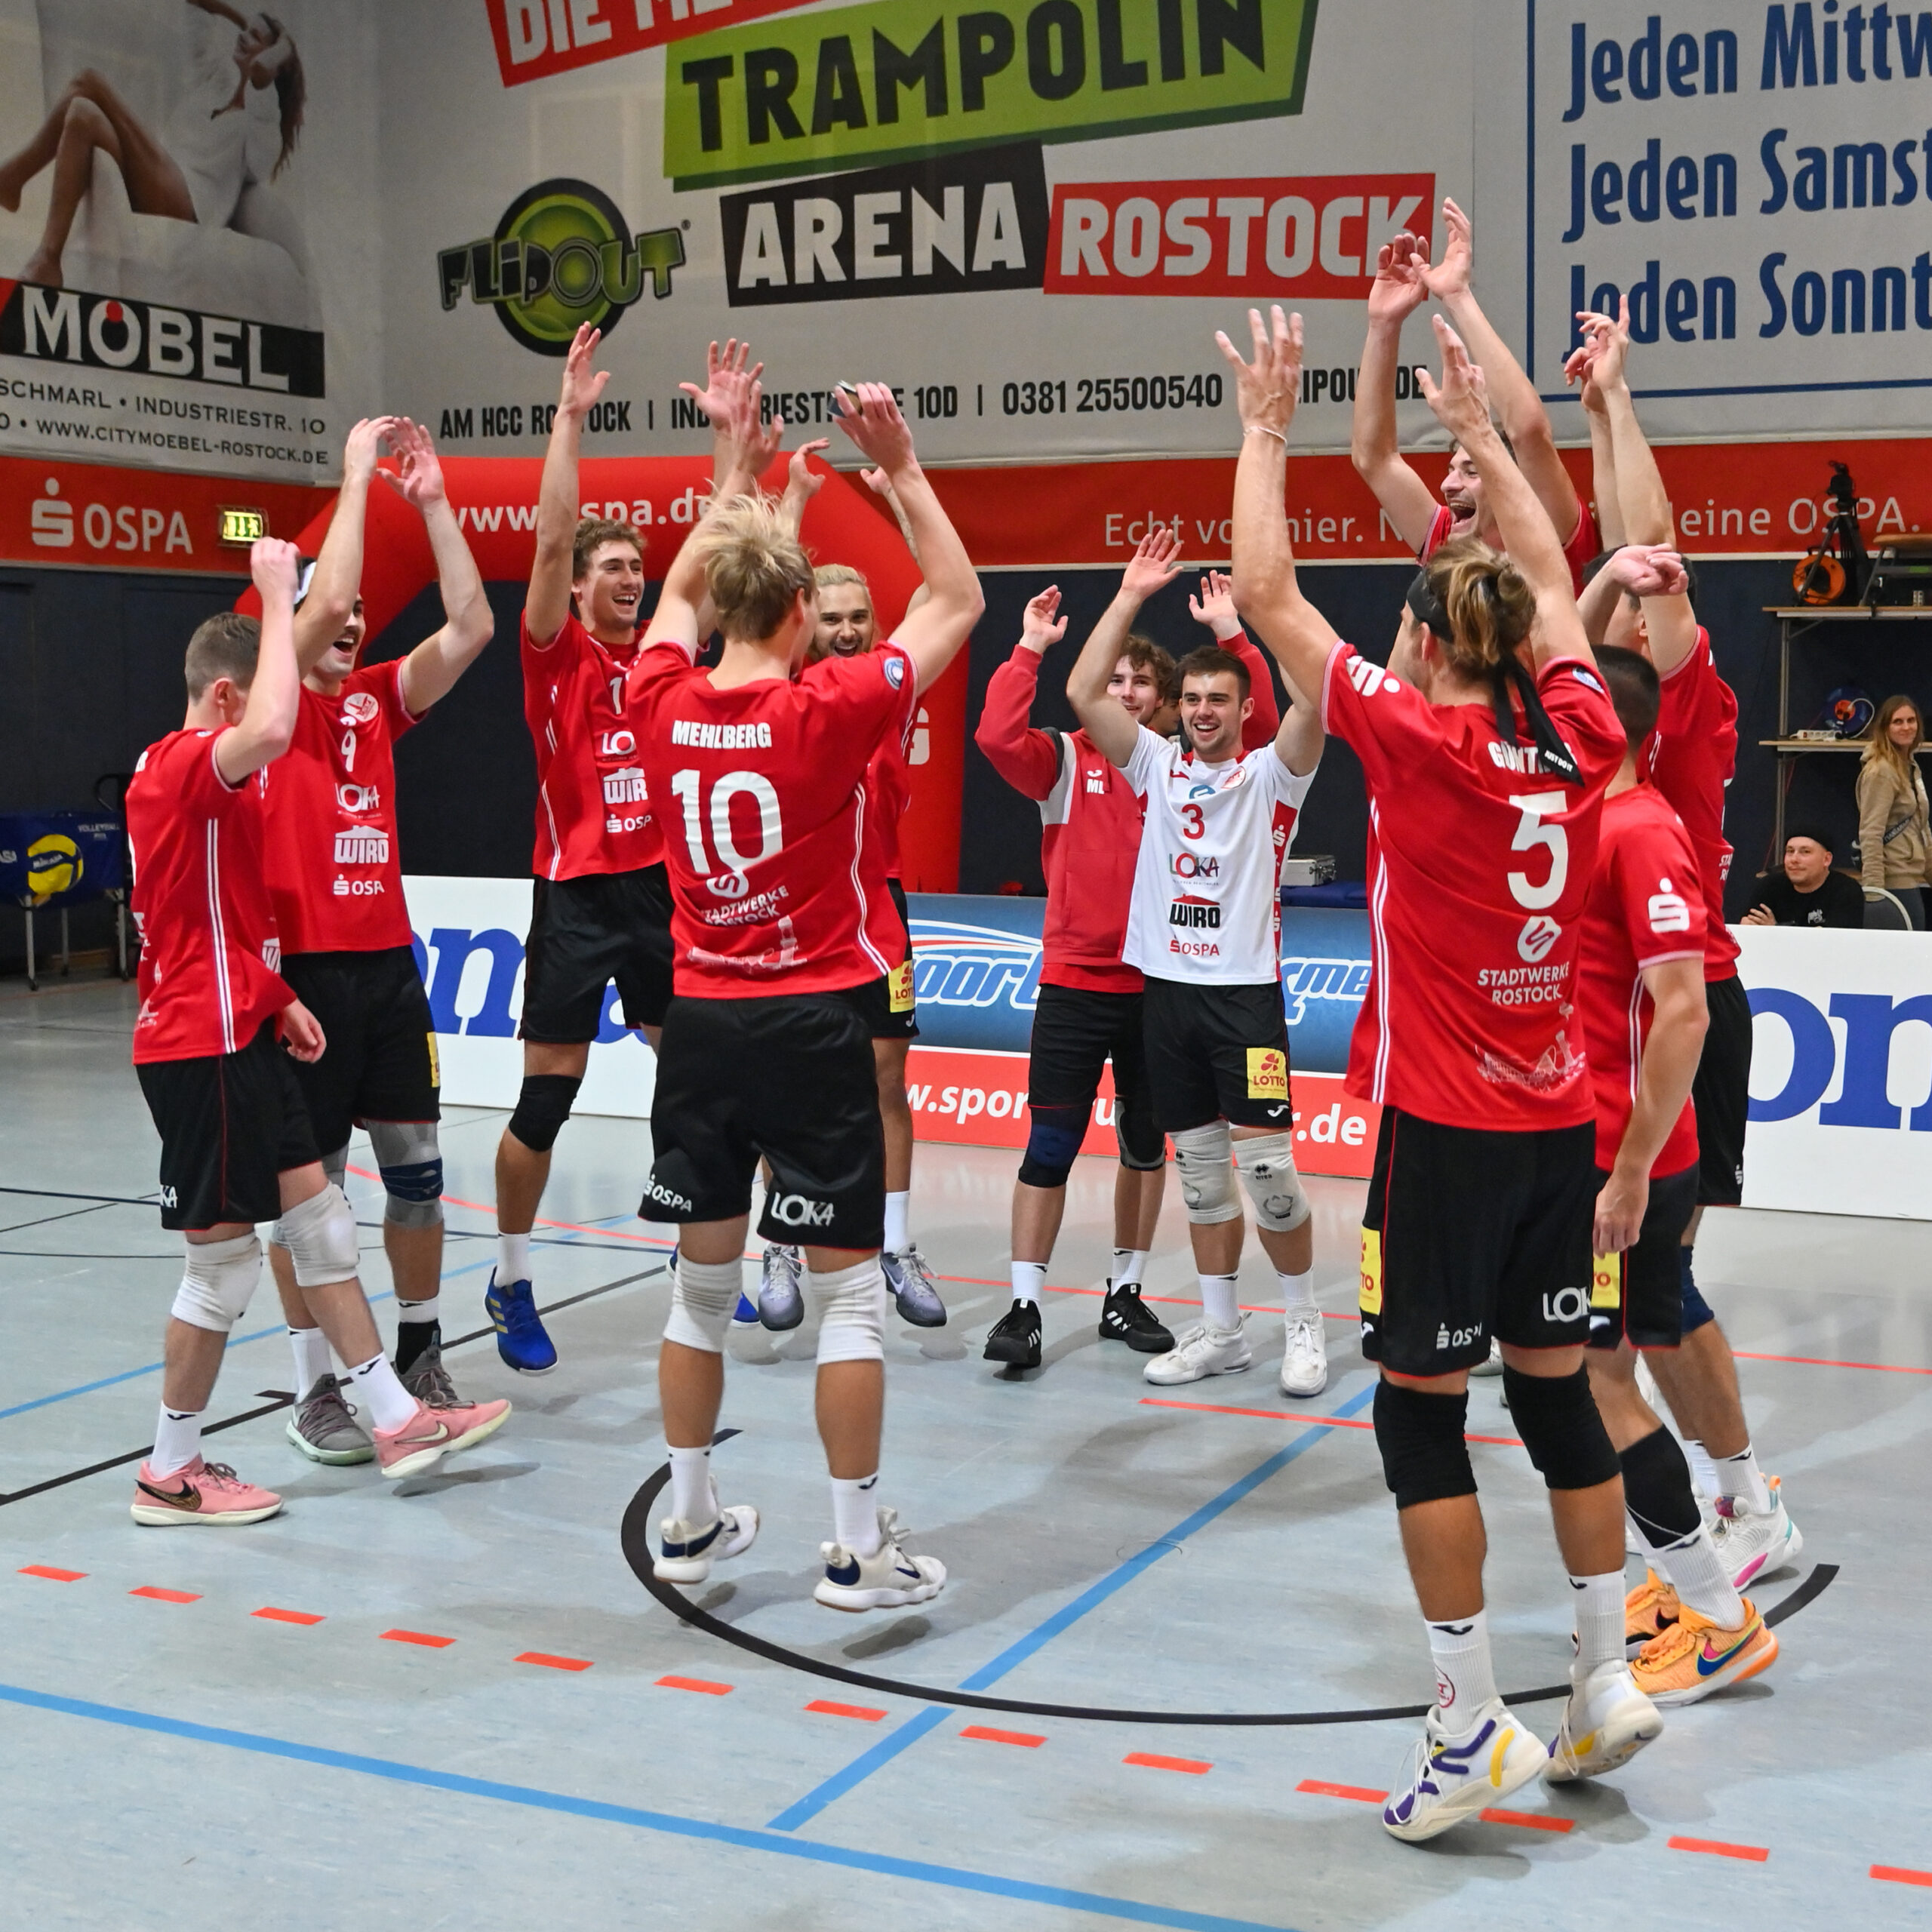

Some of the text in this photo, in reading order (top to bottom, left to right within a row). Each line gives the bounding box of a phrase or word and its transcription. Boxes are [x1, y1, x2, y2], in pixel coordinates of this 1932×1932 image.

[504, 0, 612, 65] DIE
[682, 0, 1266, 152] TRAMPOLIN
[1562, 16, 1737, 122] Jeden
[1562, 138, 1737, 243] Jeden
[737, 181, 1424, 290] ARENA ROSTOCK
[914, 386, 958, 419] 10D
[1002, 374, 1223, 415] 0381 25500540
[137, 395, 293, 432] INDUSTRIESTR.
[302, 417, 325, 435] 10
[440, 401, 632, 438] AM HCC ROOCK
[37, 420, 328, 465] WWW.CITYMOEBEL-ROSTOCK.DE
[84, 503, 193, 555] OSPA
[1106, 510, 1185, 546] Echt
[1669, 498, 1771, 537] eine
[341, 728, 356, 773] 9
[672, 719, 773, 749] MEHLBERG
[605, 777, 649, 805] WIR
[1087, 778, 1105, 795] ML
[623, 814, 653, 832] OSP
[672, 768, 783, 875] 10
[1181, 804, 1205, 840] 3
[334, 838, 389, 864] WIRO
[1169, 852, 1220, 878] LOKA
[1507, 789, 1570, 910] 5
[1169, 904, 1220, 929] WIRO
[1182, 943, 1220, 956] OSPA
[1477, 961, 1570, 986] STADTWERKE
[1491, 983, 1563, 1006] ROSTOCK
[1253, 1075, 1285, 1087] LOTTO
[652, 1184, 693, 1214] OSPA
[771, 1191, 835, 1227] LOKA
